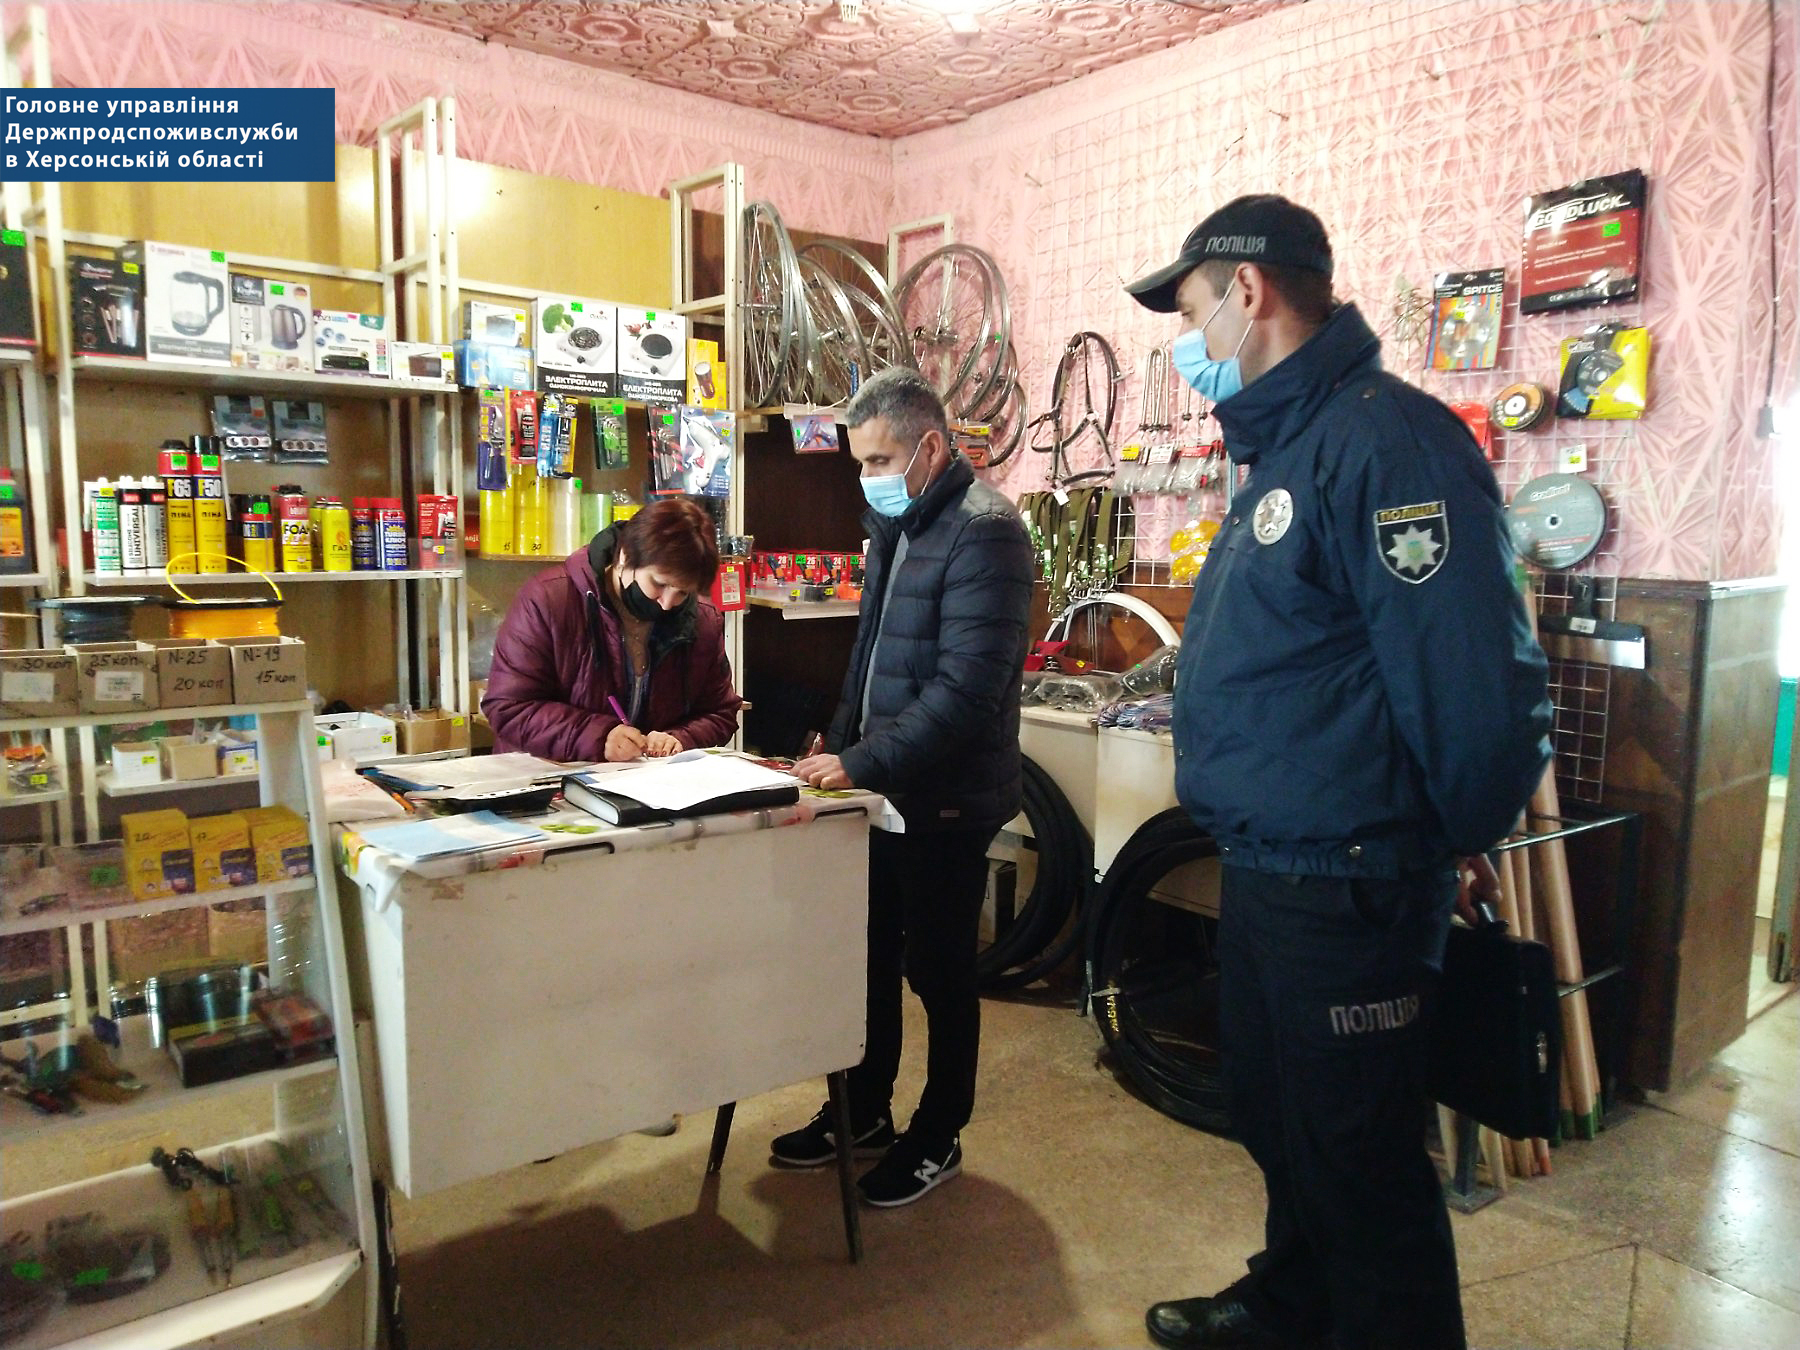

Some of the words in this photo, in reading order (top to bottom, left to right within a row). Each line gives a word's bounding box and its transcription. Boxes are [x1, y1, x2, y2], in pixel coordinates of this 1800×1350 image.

[1205, 236, 1267, 253] ПОЛІЦІЯ
[545, 375, 609, 389] ЭЛЕКТРОПЛИТА
[167, 479, 191, 497] F65
[198, 479, 222, 497] F50
[132, 508, 142, 557] UNIVERSAL
[174, 678, 196, 691] 20
